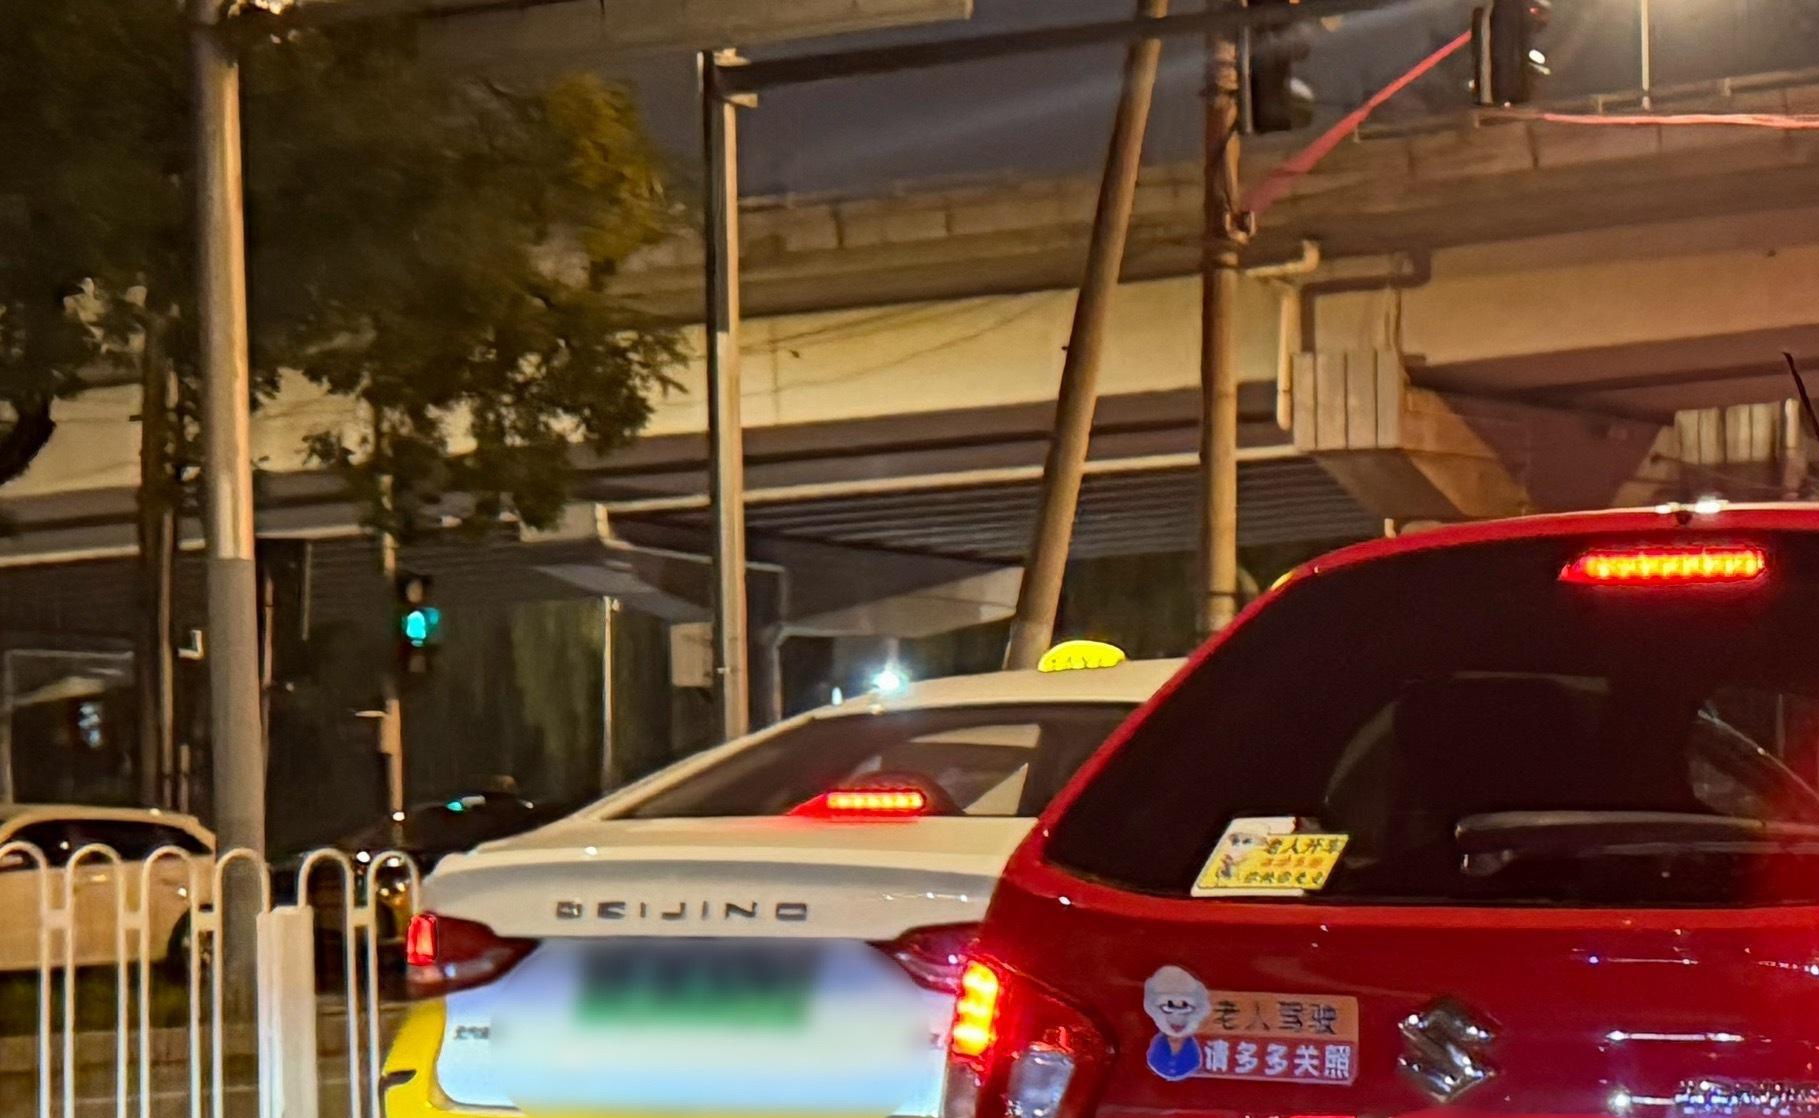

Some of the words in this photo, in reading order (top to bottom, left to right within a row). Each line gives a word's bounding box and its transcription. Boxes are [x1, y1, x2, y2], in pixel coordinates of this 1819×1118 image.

[555, 900, 808, 921] BEIJING
[1212, 1000, 1337, 1035] 老人驾驶
[1204, 1039, 1351, 1079] 请多多关照
